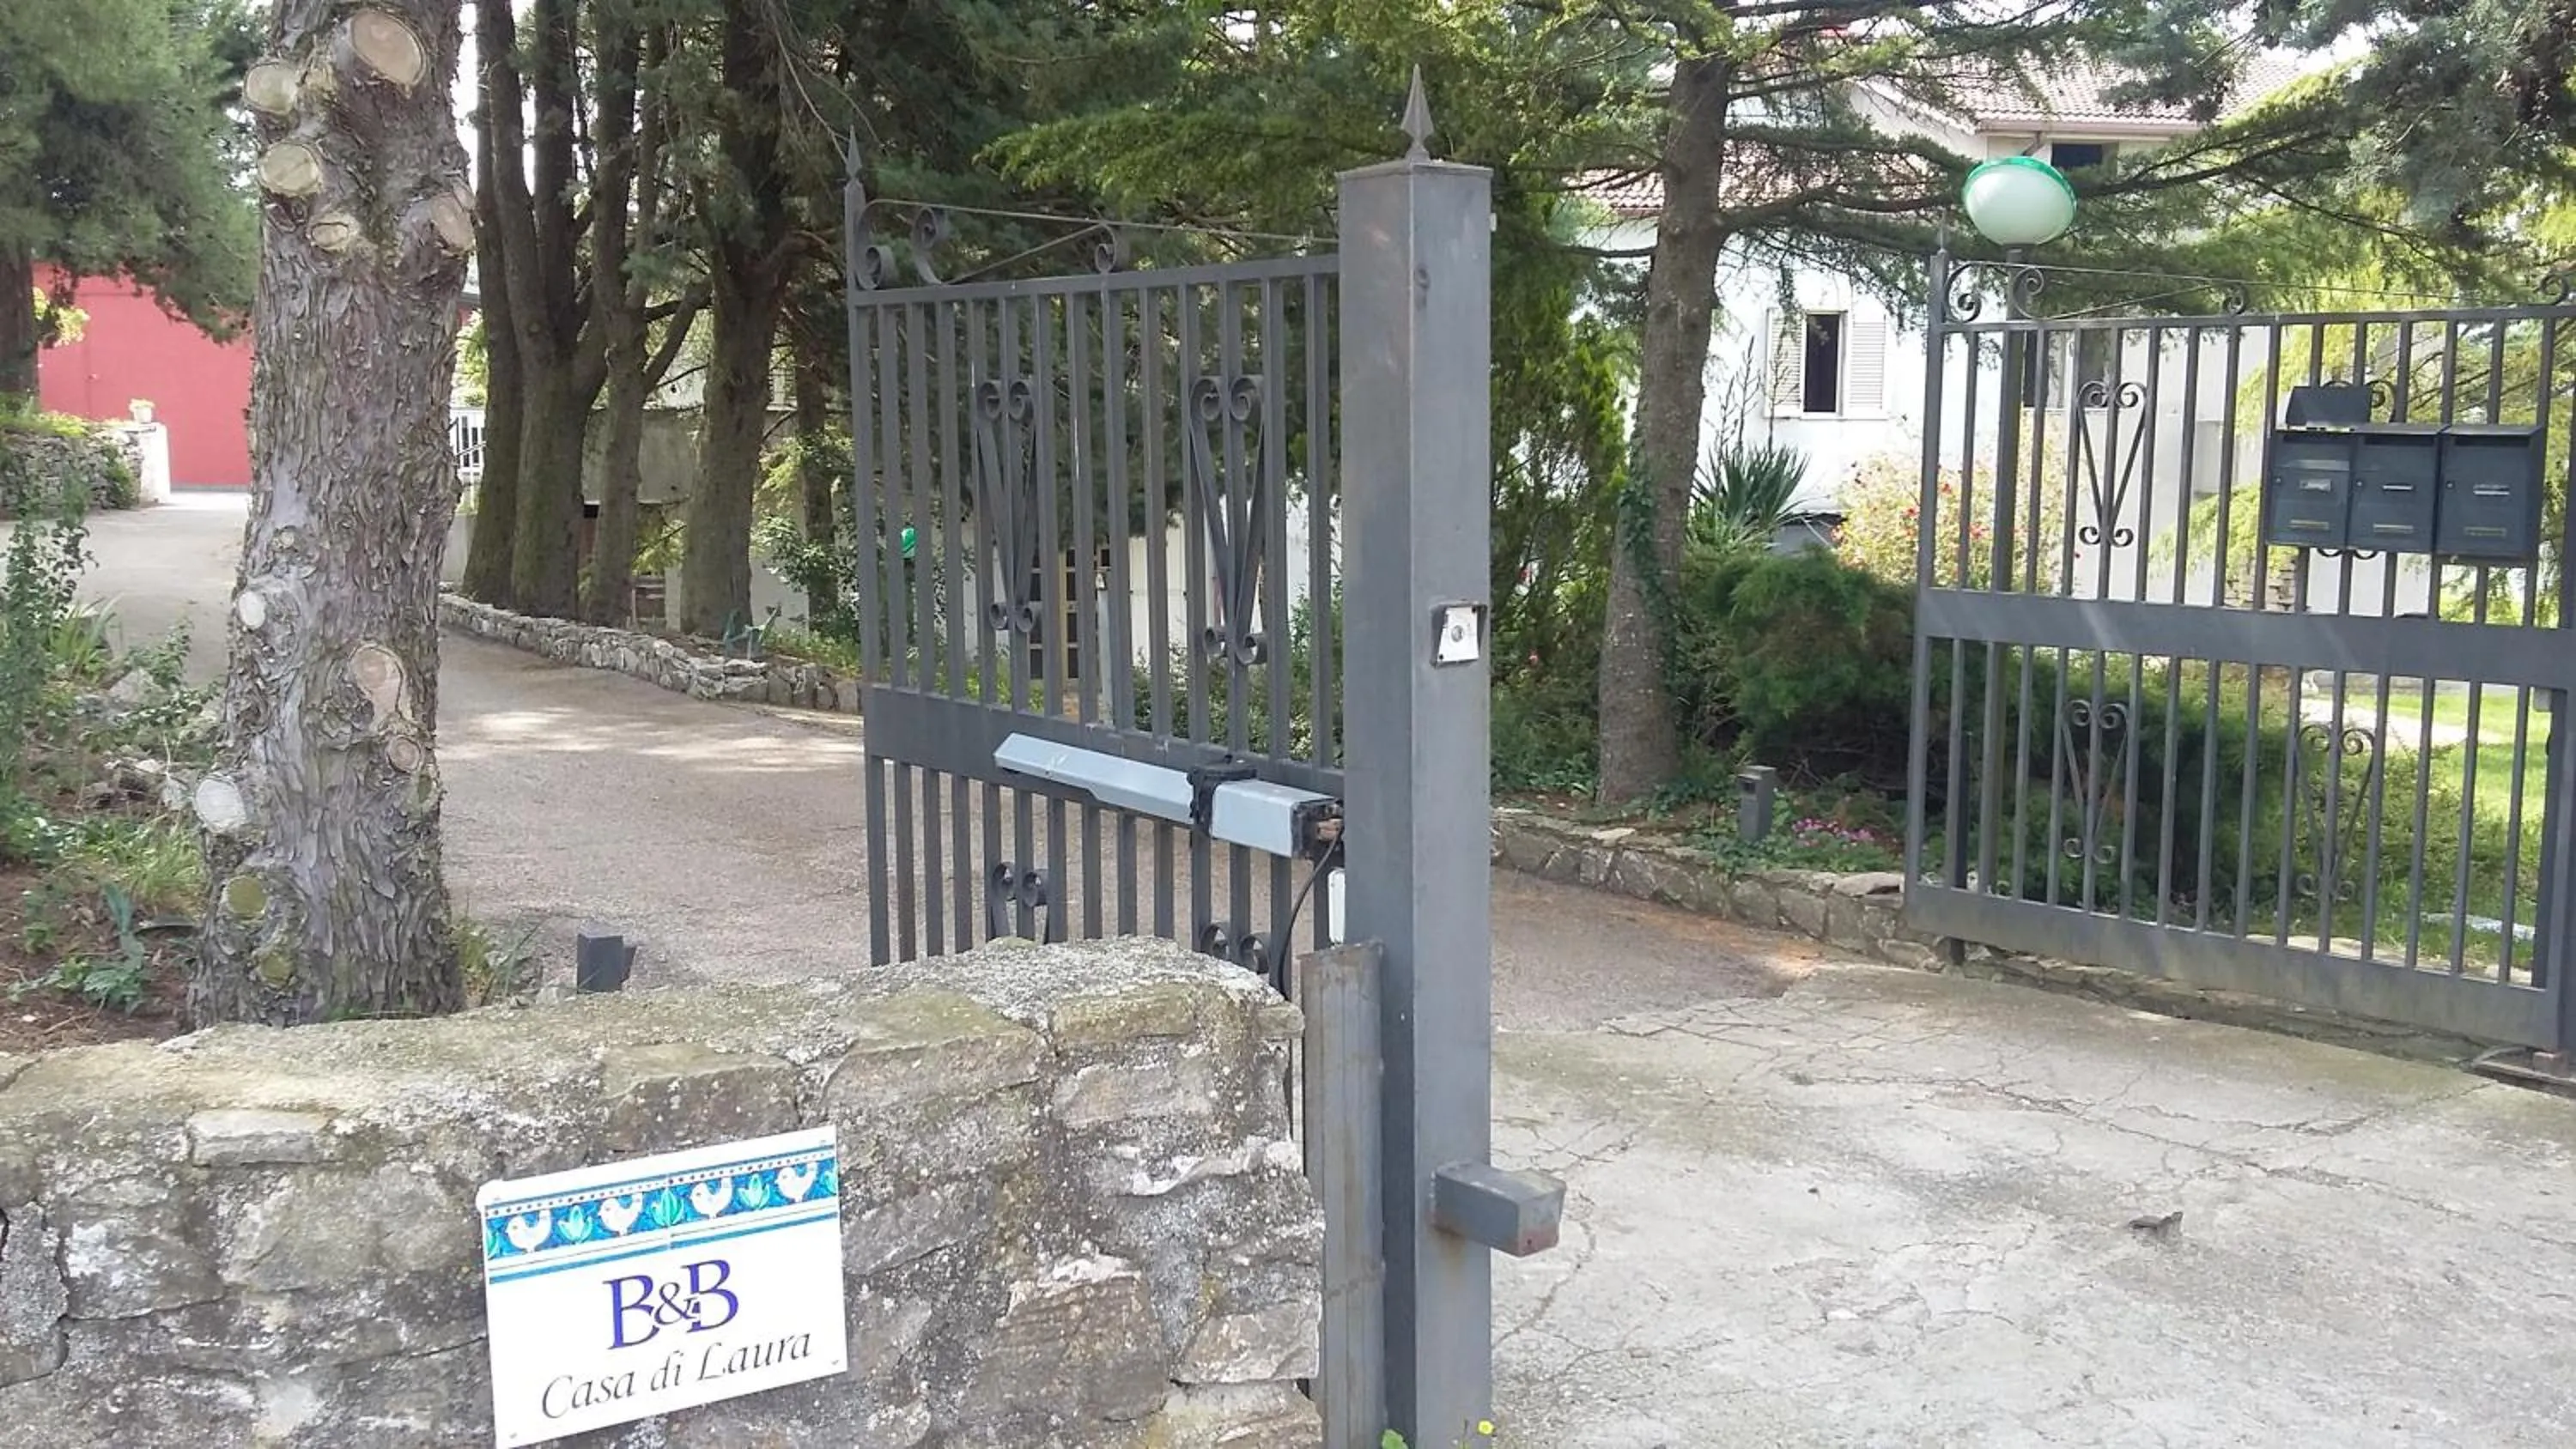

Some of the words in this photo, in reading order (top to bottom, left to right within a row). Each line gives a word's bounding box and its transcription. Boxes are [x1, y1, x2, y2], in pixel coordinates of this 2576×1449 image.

[603, 1259, 739, 1350] B&B
[542, 1372, 635, 1419] Casa
[650, 1351, 684, 1391] di
[696, 1332, 811, 1381] Laura
